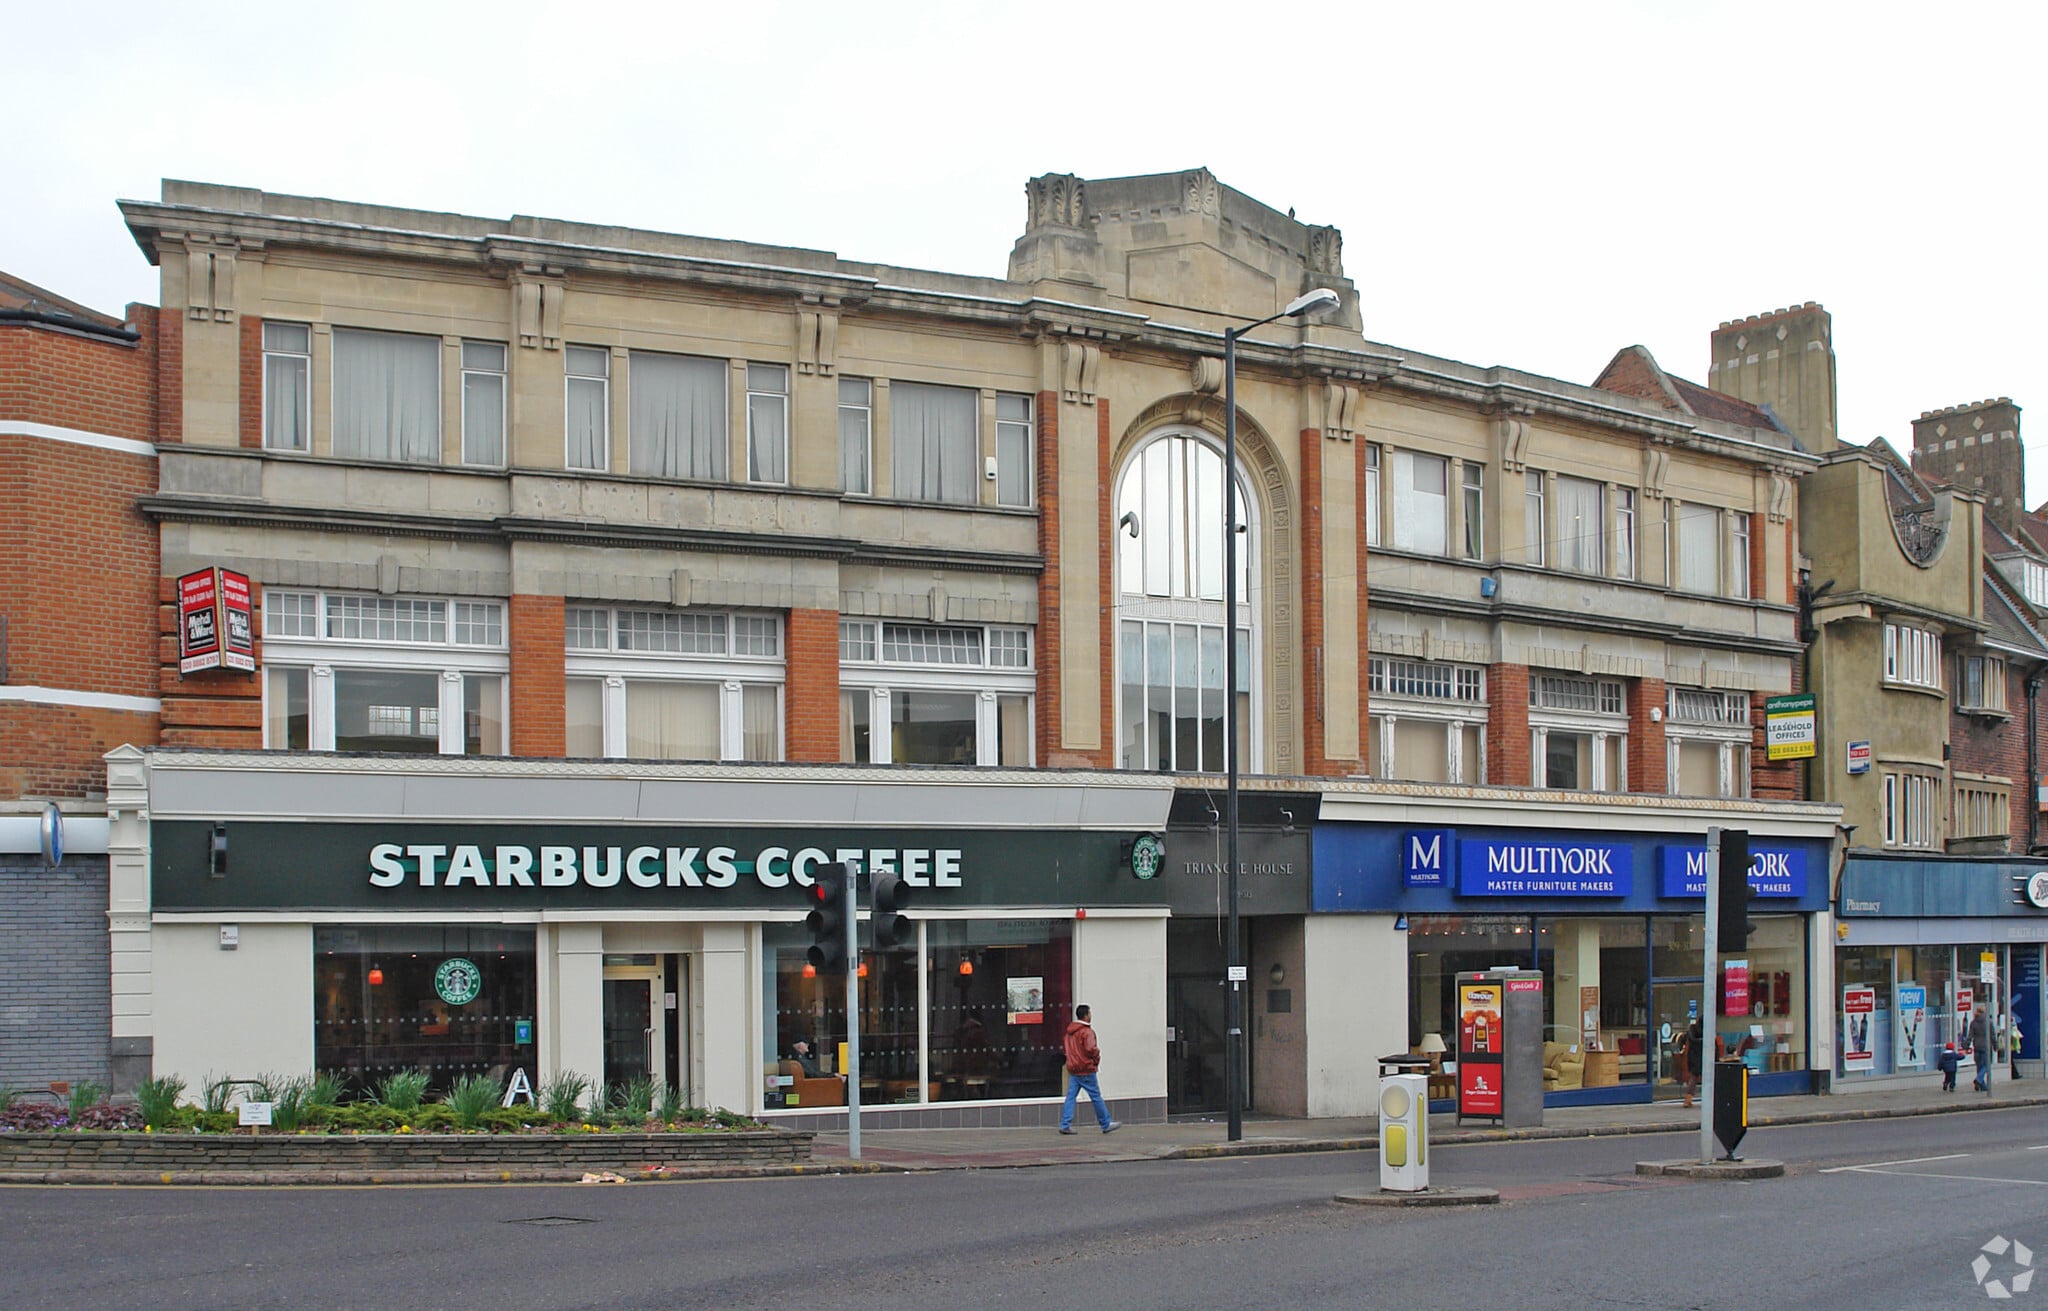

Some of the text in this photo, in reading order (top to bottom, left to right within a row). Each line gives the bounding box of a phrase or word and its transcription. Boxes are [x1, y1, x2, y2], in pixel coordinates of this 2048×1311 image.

[188, 611, 211, 628] Mehdi
[229, 611, 247, 627] Mehdi
[1768, 722, 1812, 732] LEASEHOLD
[1775, 731, 1805, 740] OFFICES
[1411, 835, 1440, 869] M
[369, 844, 738, 888] STARBUCKS
[1487, 846, 1613, 874] MULTIYORK
[1184, 862, 1293, 874] TRIANGE HOUSE
[1487, 880, 1614, 892] MASTER FURNITURE MAKERS
[1686, 883, 1707, 893] MAST
[1763, 883, 1791, 893] MAKERS
[1846, 898, 1880, 913] Pharmacy
[438, 960, 479, 981] STARBUCKS
[441, 990, 473, 1003] COFFEE
[1900, 991, 1921, 1005] new
